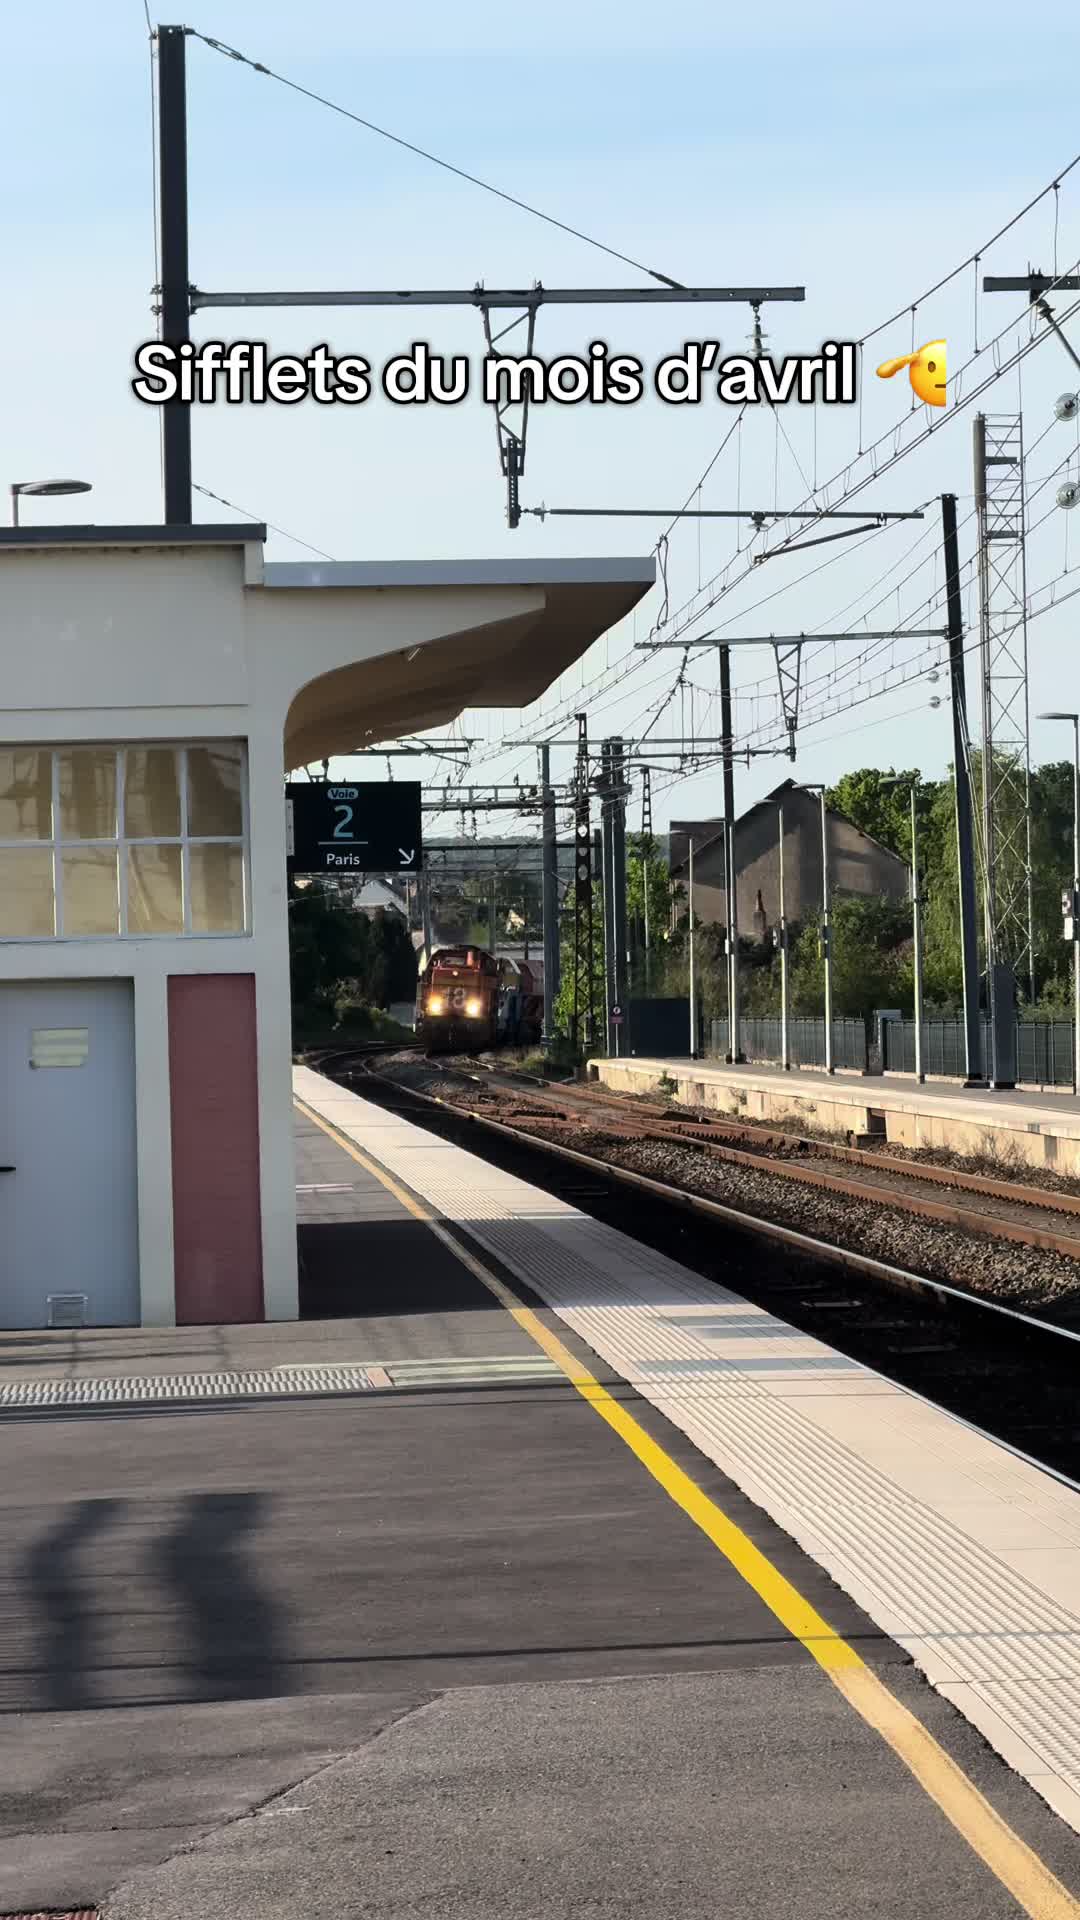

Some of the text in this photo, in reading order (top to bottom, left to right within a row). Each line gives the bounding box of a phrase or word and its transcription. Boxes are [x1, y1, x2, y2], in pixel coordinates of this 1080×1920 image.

[330, 788, 355, 799] Voie
[333, 804, 354, 838] 2
[326, 853, 361, 866] Paris
